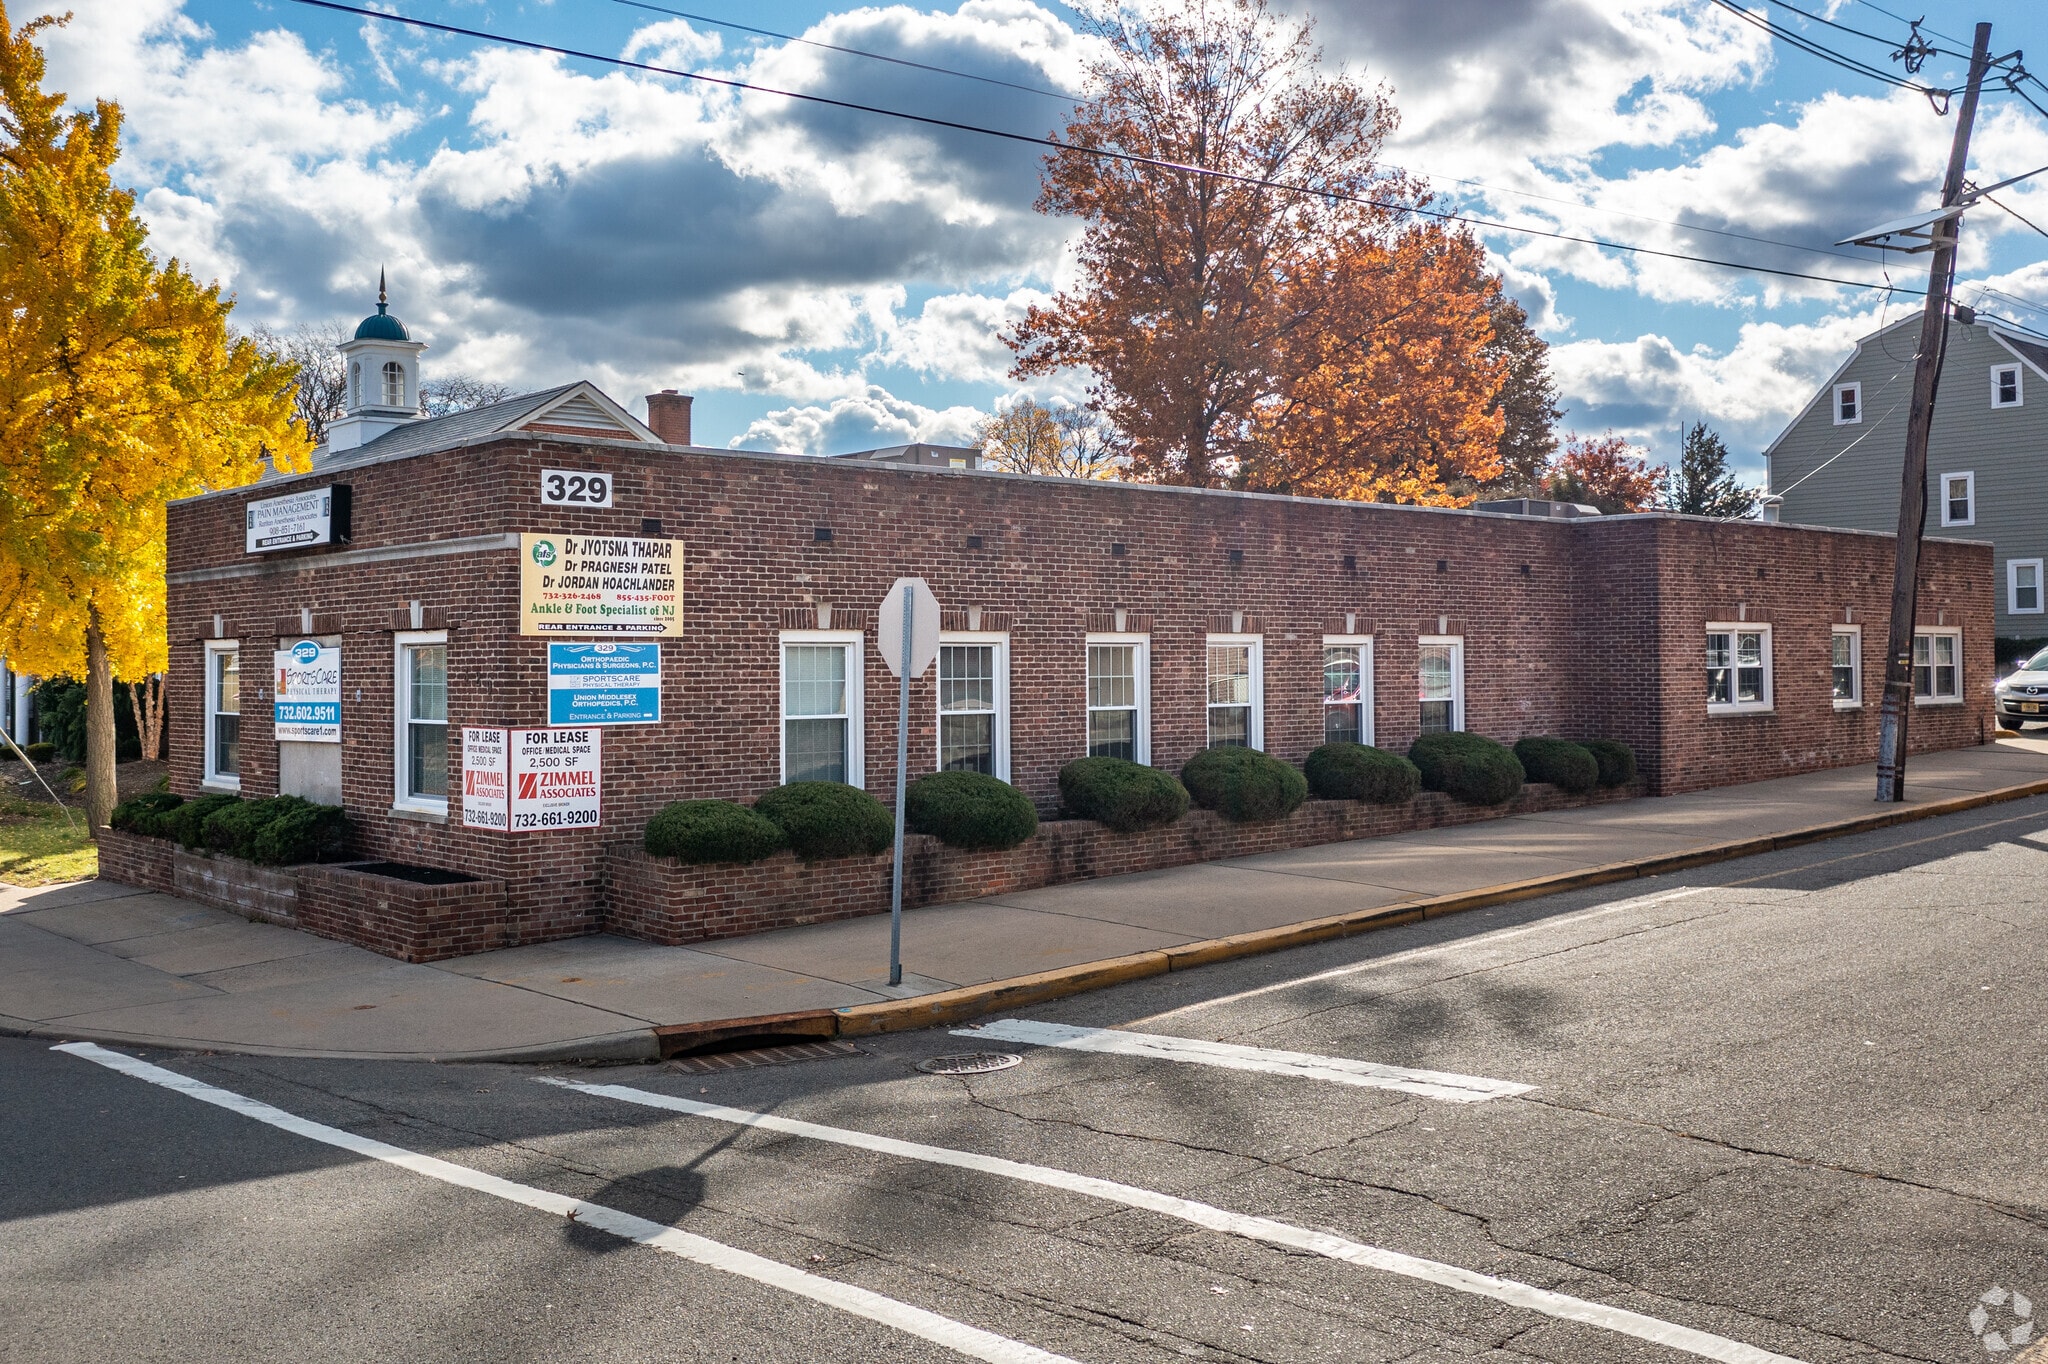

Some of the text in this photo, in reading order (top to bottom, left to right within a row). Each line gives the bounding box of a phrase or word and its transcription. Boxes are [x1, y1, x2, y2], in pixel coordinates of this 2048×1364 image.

[547, 474, 607, 503] 329
[257, 508, 272, 519] PAIN
[272, 500, 320, 517] MANAGEMENT
[269, 523, 306, 536] 908-851-7161
[565, 538, 672, 559] Dr JYOTSNA THAPAR
[565, 560, 672, 575] Dr PRAGNESH PATEL
[542, 575, 675, 591] Dr JORDAN HOACHLANDER
[542, 592, 675, 602] 732-326-2468 855-435-FOOT
[530, 602, 675, 617] Ankle & Foot Specialist of NJ
[565, 623, 613, 631] ENTRANCE
[625, 624, 664, 632] PARKING
[295, 647, 316, 658] 329
[597, 644, 614, 652] 329
[286, 687, 338, 695] PHYSICAL THERAPY
[279, 706, 335, 721] 732.602.9511
[277, 726, 337, 737] www.sportscare1.com
[468, 731, 500, 743] FOR LEASE
[526, 731, 589, 744] FOR LEASE
[572, 745, 591, 754] SPACE
[488, 757, 496, 767] SF
[530, 757, 579, 769] 2,500 SF
[476, 771, 504, 787] ZIMMEL
[540, 771, 596, 787] ZIMMEL
[476, 787, 505, 799] ASSOCIATES
[540, 787, 596, 799] ASSOCIATES
[465, 809, 507, 827] 732-661-9200
[515, 810, 597, 827] 732-661-9200
